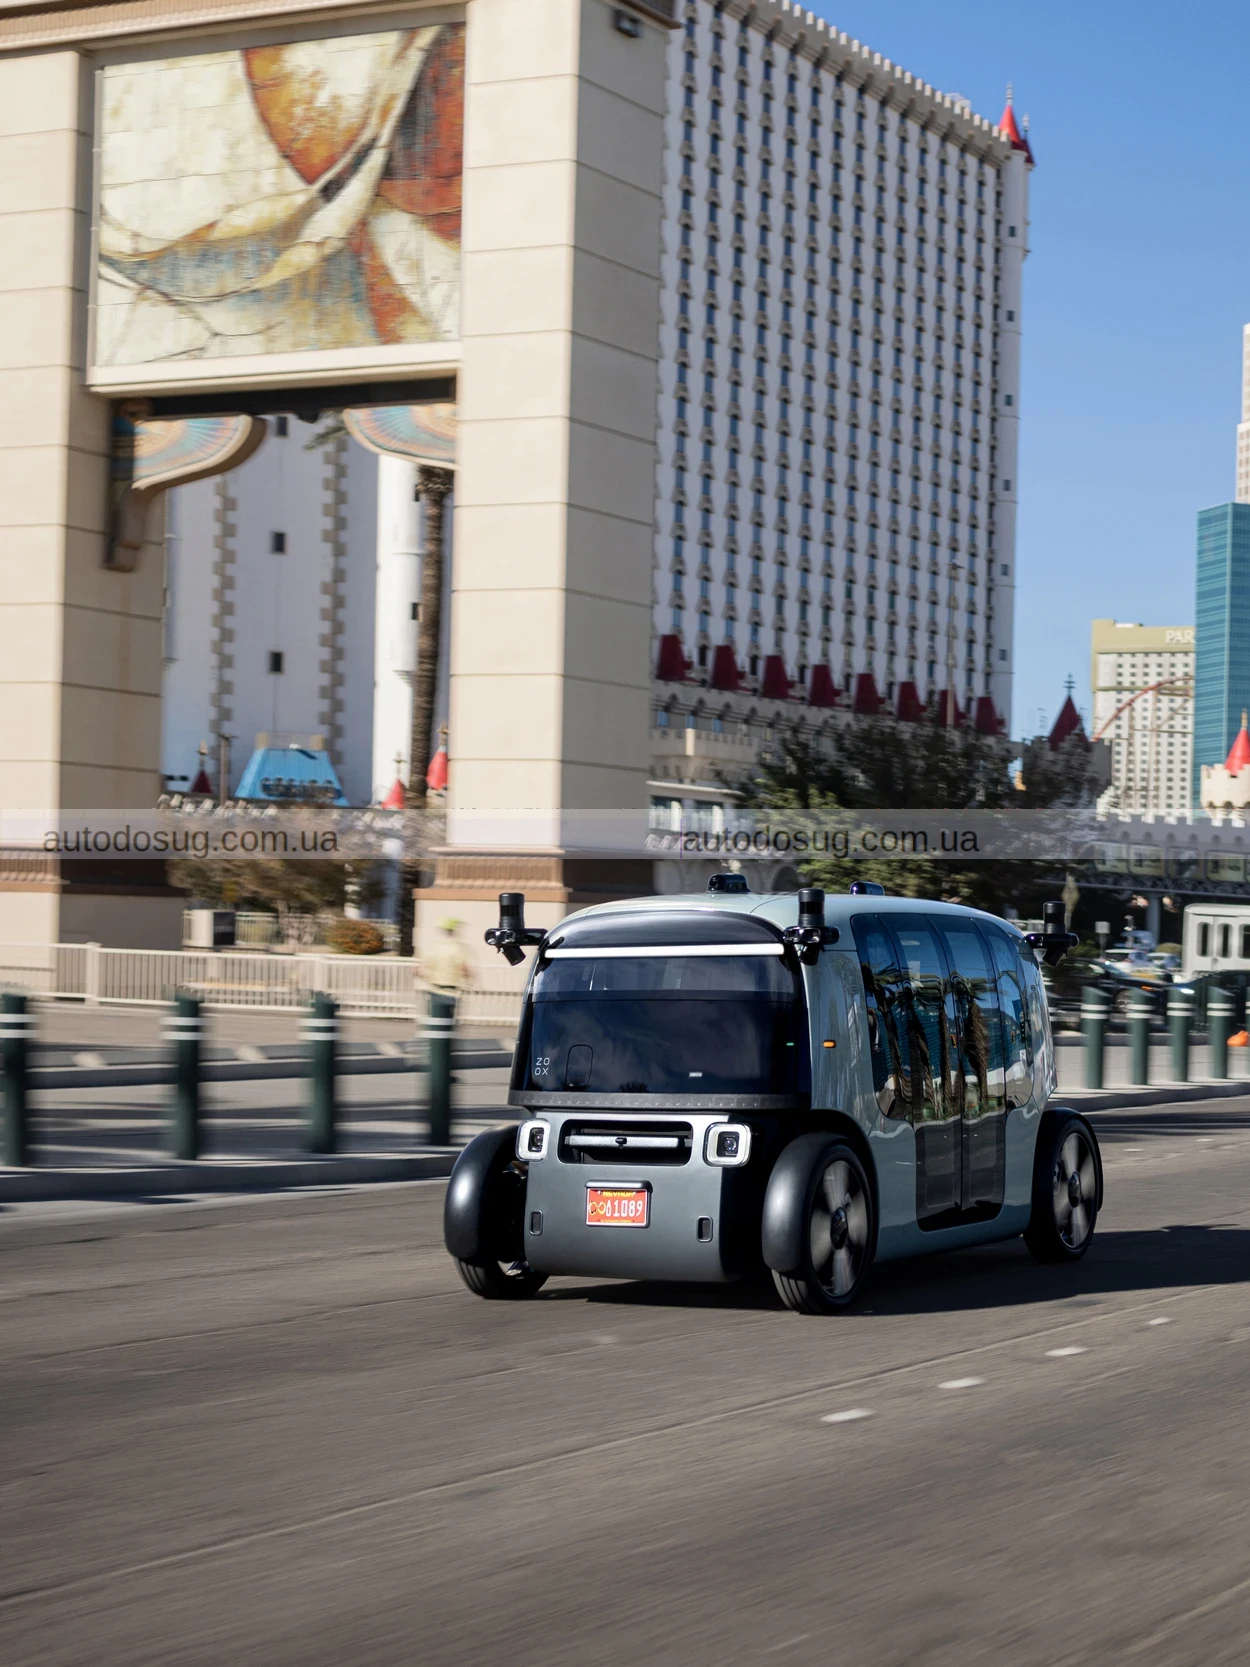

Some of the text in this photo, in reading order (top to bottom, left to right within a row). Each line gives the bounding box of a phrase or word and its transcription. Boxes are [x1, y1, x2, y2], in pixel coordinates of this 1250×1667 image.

[1166, 629, 1196, 644] PAR
[536, 1057, 550, 1066] ZO
[534, 1067, 549, 1076] OX
